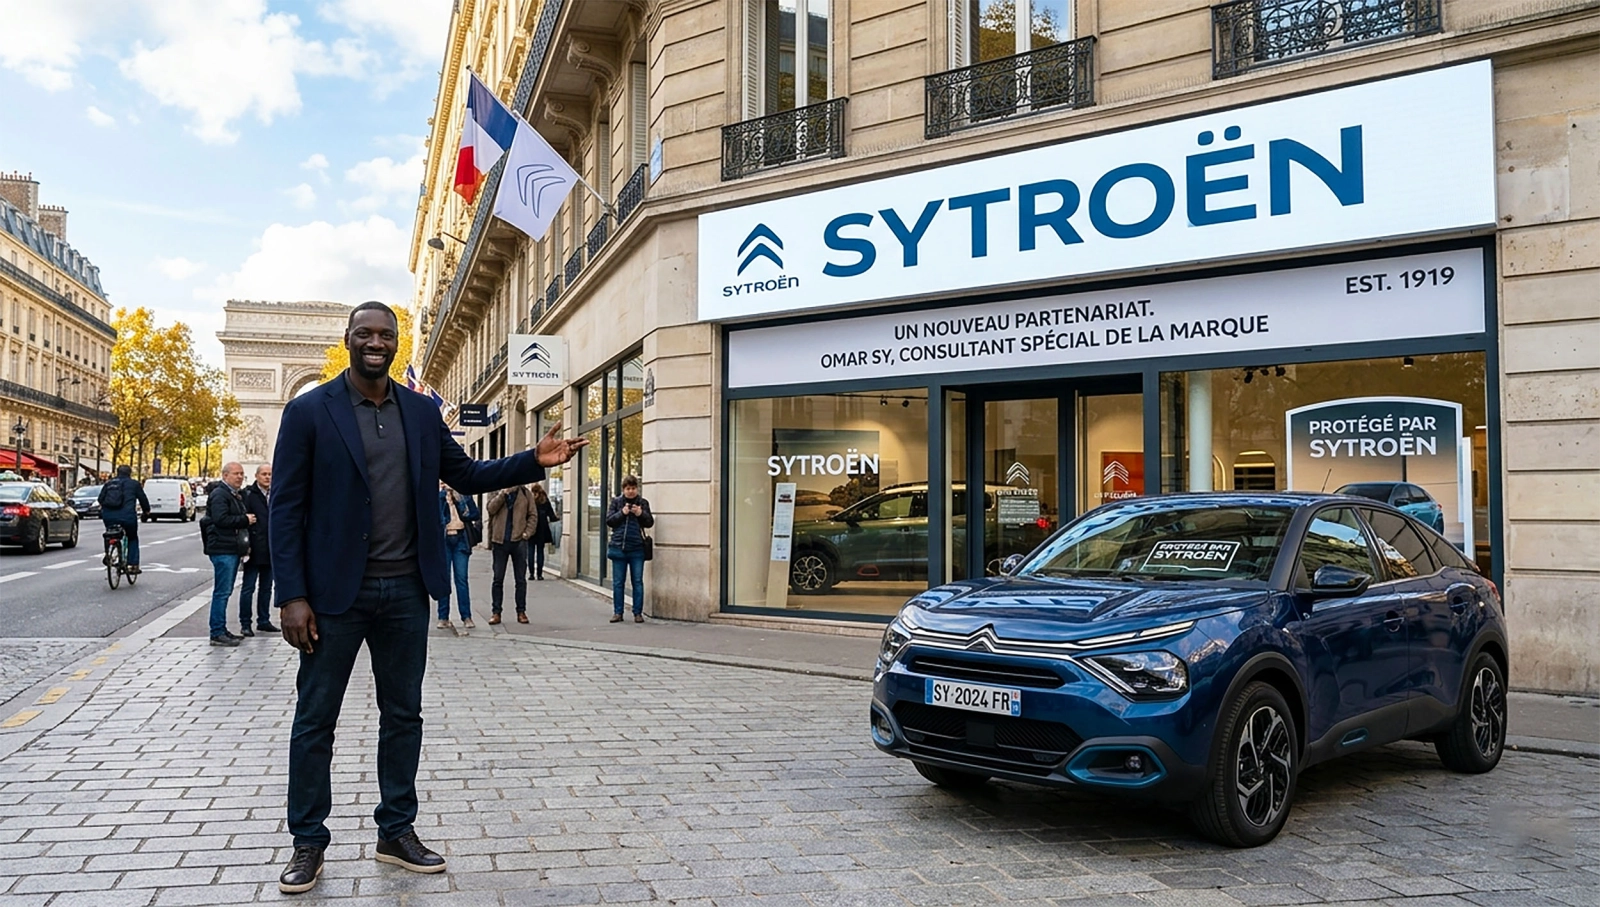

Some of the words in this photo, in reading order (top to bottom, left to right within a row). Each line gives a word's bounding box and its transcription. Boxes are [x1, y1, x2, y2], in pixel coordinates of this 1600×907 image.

[822, 124, 1364, 277] SYTROËN
[1345, 273, 1392, 294] EST.
[1399, 266, 1455, 289] 1919
[894, 323, 918, 340] UN
[923, 314, 1010, 337] NOUVEAU
[1015, 299, 1154, 329] PARTENARIAT.
[820, 350, 868, 368] OMAR
[872, 348, 895, 366] SY,
[899, 337, 1016, 362] CONSULTANT
[1020, 329, 1100, 352] SPÉCIAL
[1106, 327, 1132, 346] DE
[1138, 324, 1164, 343] LA
[1170, 315, 1269, 341] MARQUE
[1309, 413, 1394, 434] PROTÉGÉ
[1398, 416, 1437, 431] PAR
[1309, 432, 1437, 458] SYTROËN
[767, 448, 879, 476] SYTROËN
[992, 690, 1010, 711] FR
